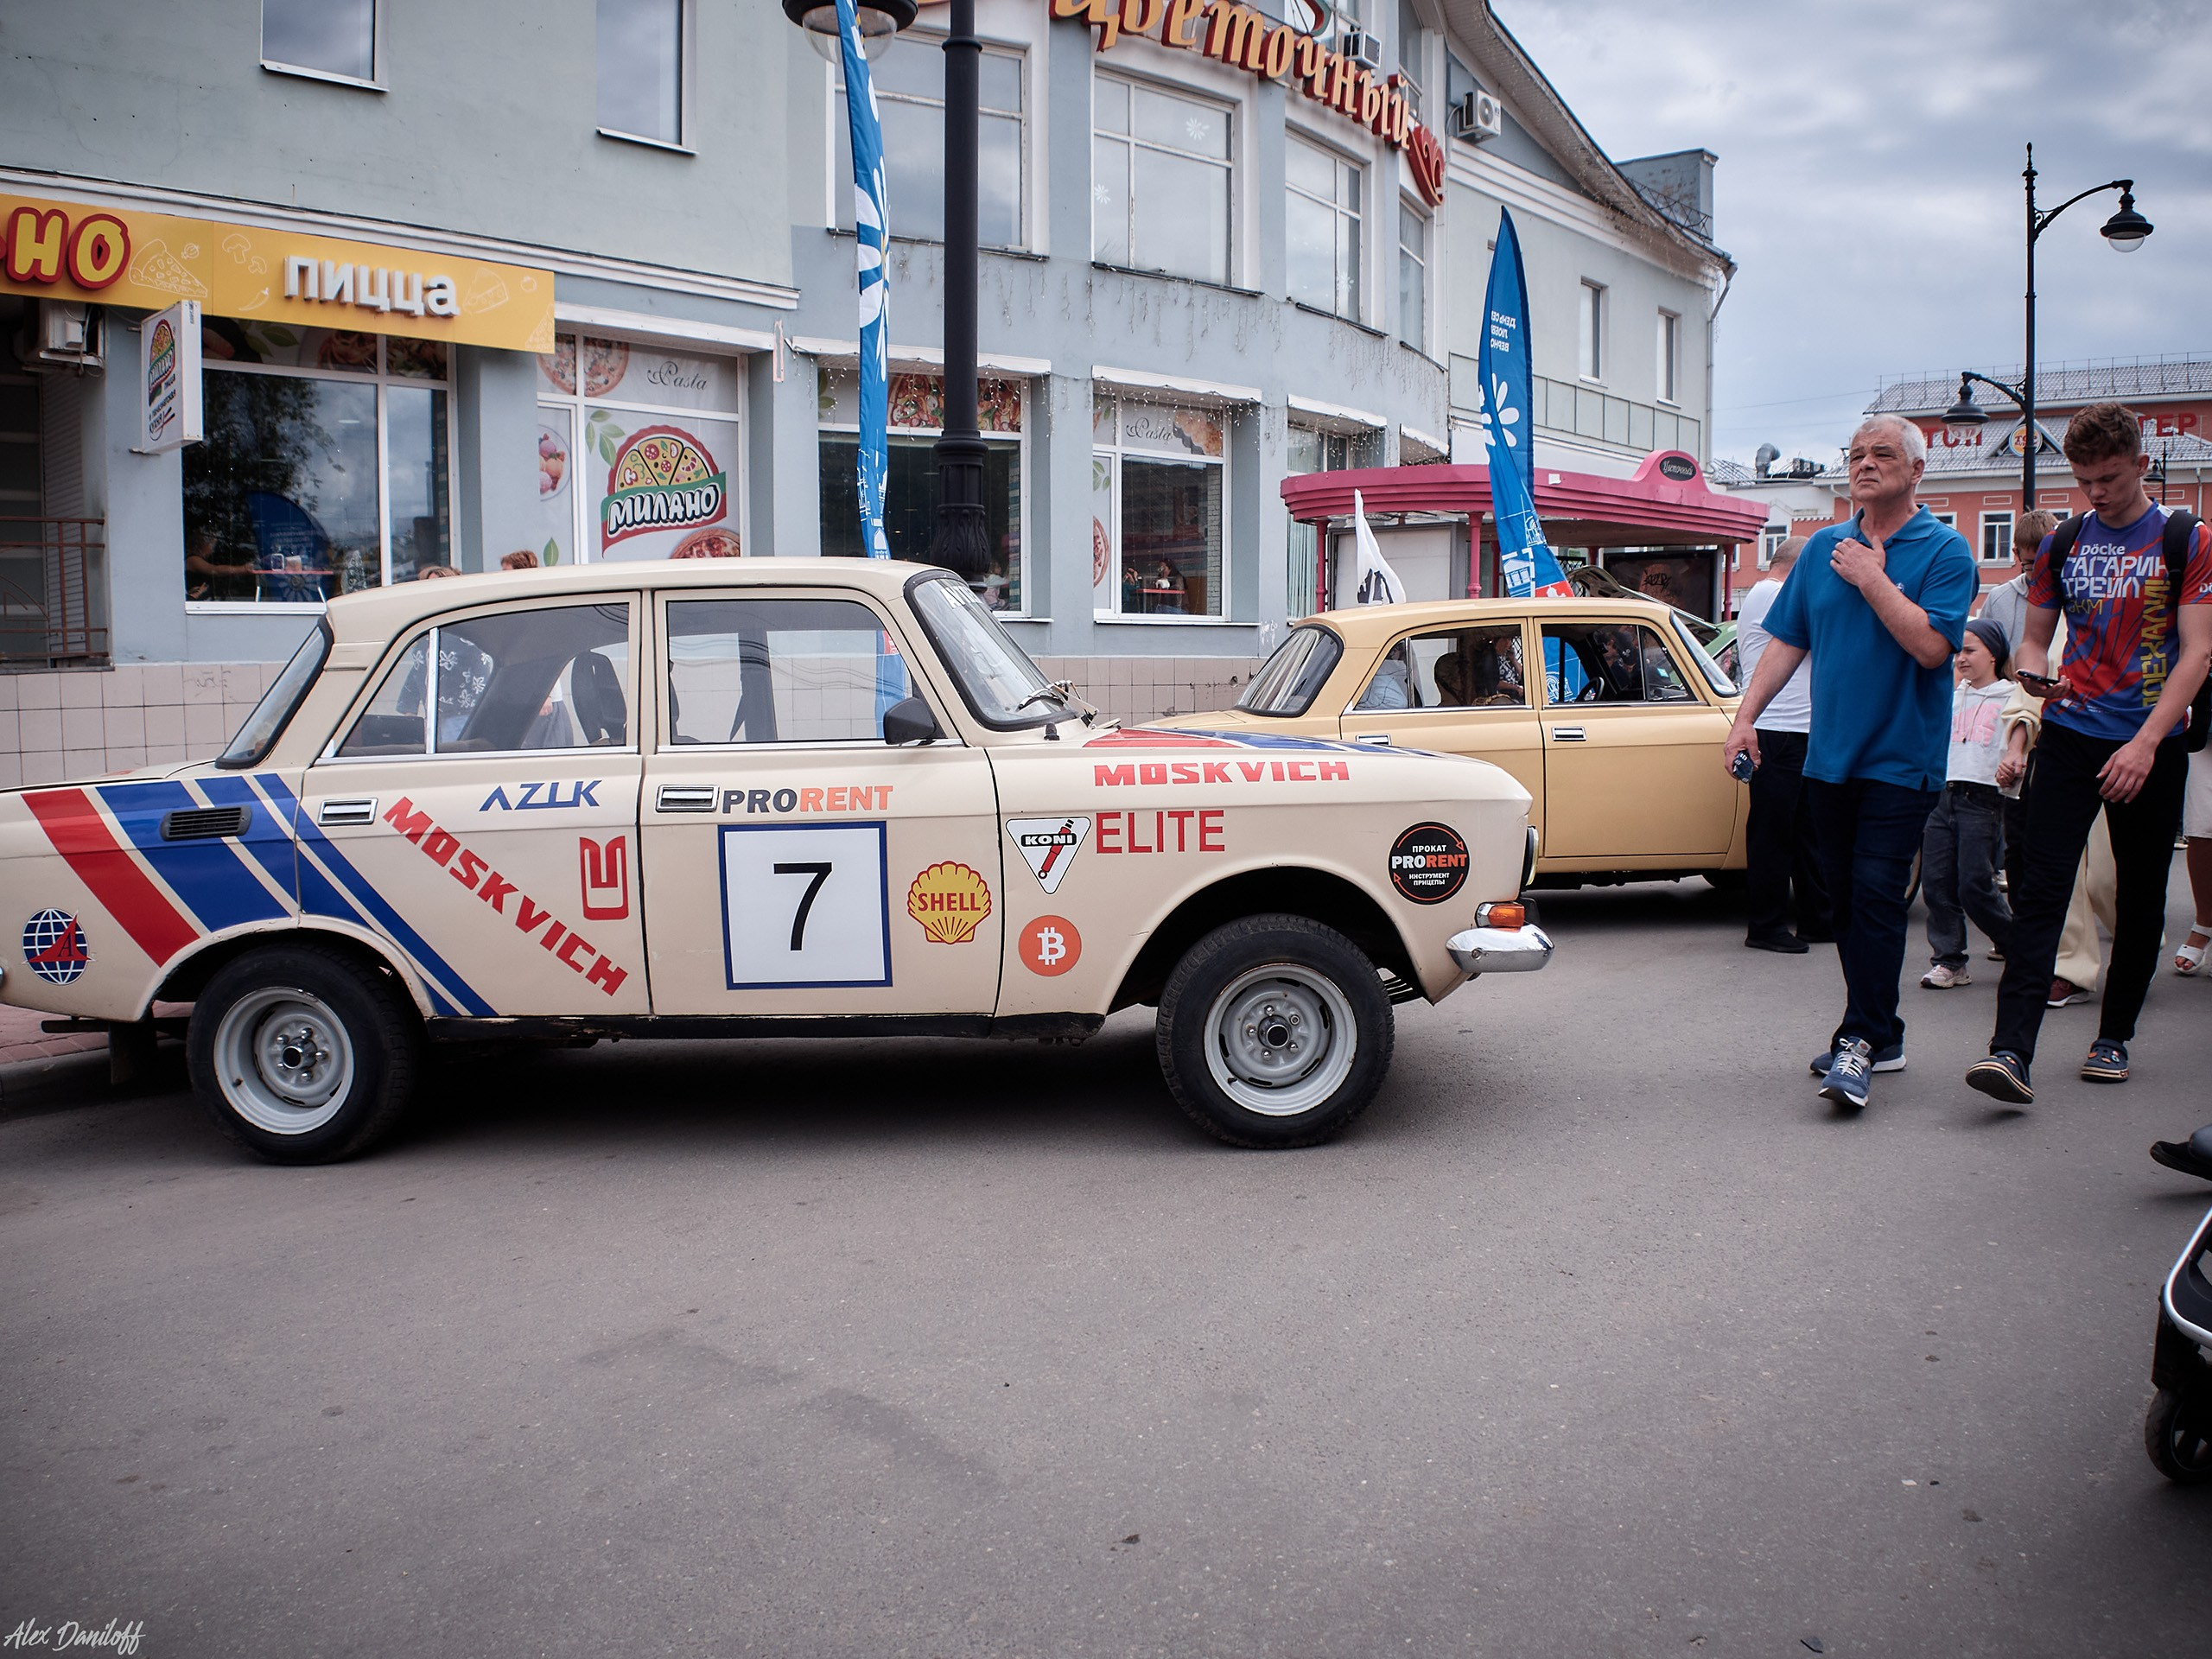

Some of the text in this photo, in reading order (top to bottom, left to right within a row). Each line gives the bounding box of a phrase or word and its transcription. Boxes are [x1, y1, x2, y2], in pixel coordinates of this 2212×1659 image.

[0, 207, 131, 290] НО
[646, 360, 708, 391] Pasta
[1126, 416, 1173, 442] Pasta
[607, 484, 721, 537] МИЛАНО
[2081, 543, 2126, 556] Döcke
[1094, 761, 1350, 787] MOSKVICH
[722, 785, 893, 814] PRORENT
[1025, 835, 1074, 846] KONI
[1096, 810, 1225, 855] ELITE
[1391, 854, 1468, 869] PRORENT
[1412, 844, 1446, 853] ПРОКАТ
[382, 796, 628, 996] MOSKVICH
[773, 862, 832, 950] 7
[918, 893, 981, 912] SHELL
